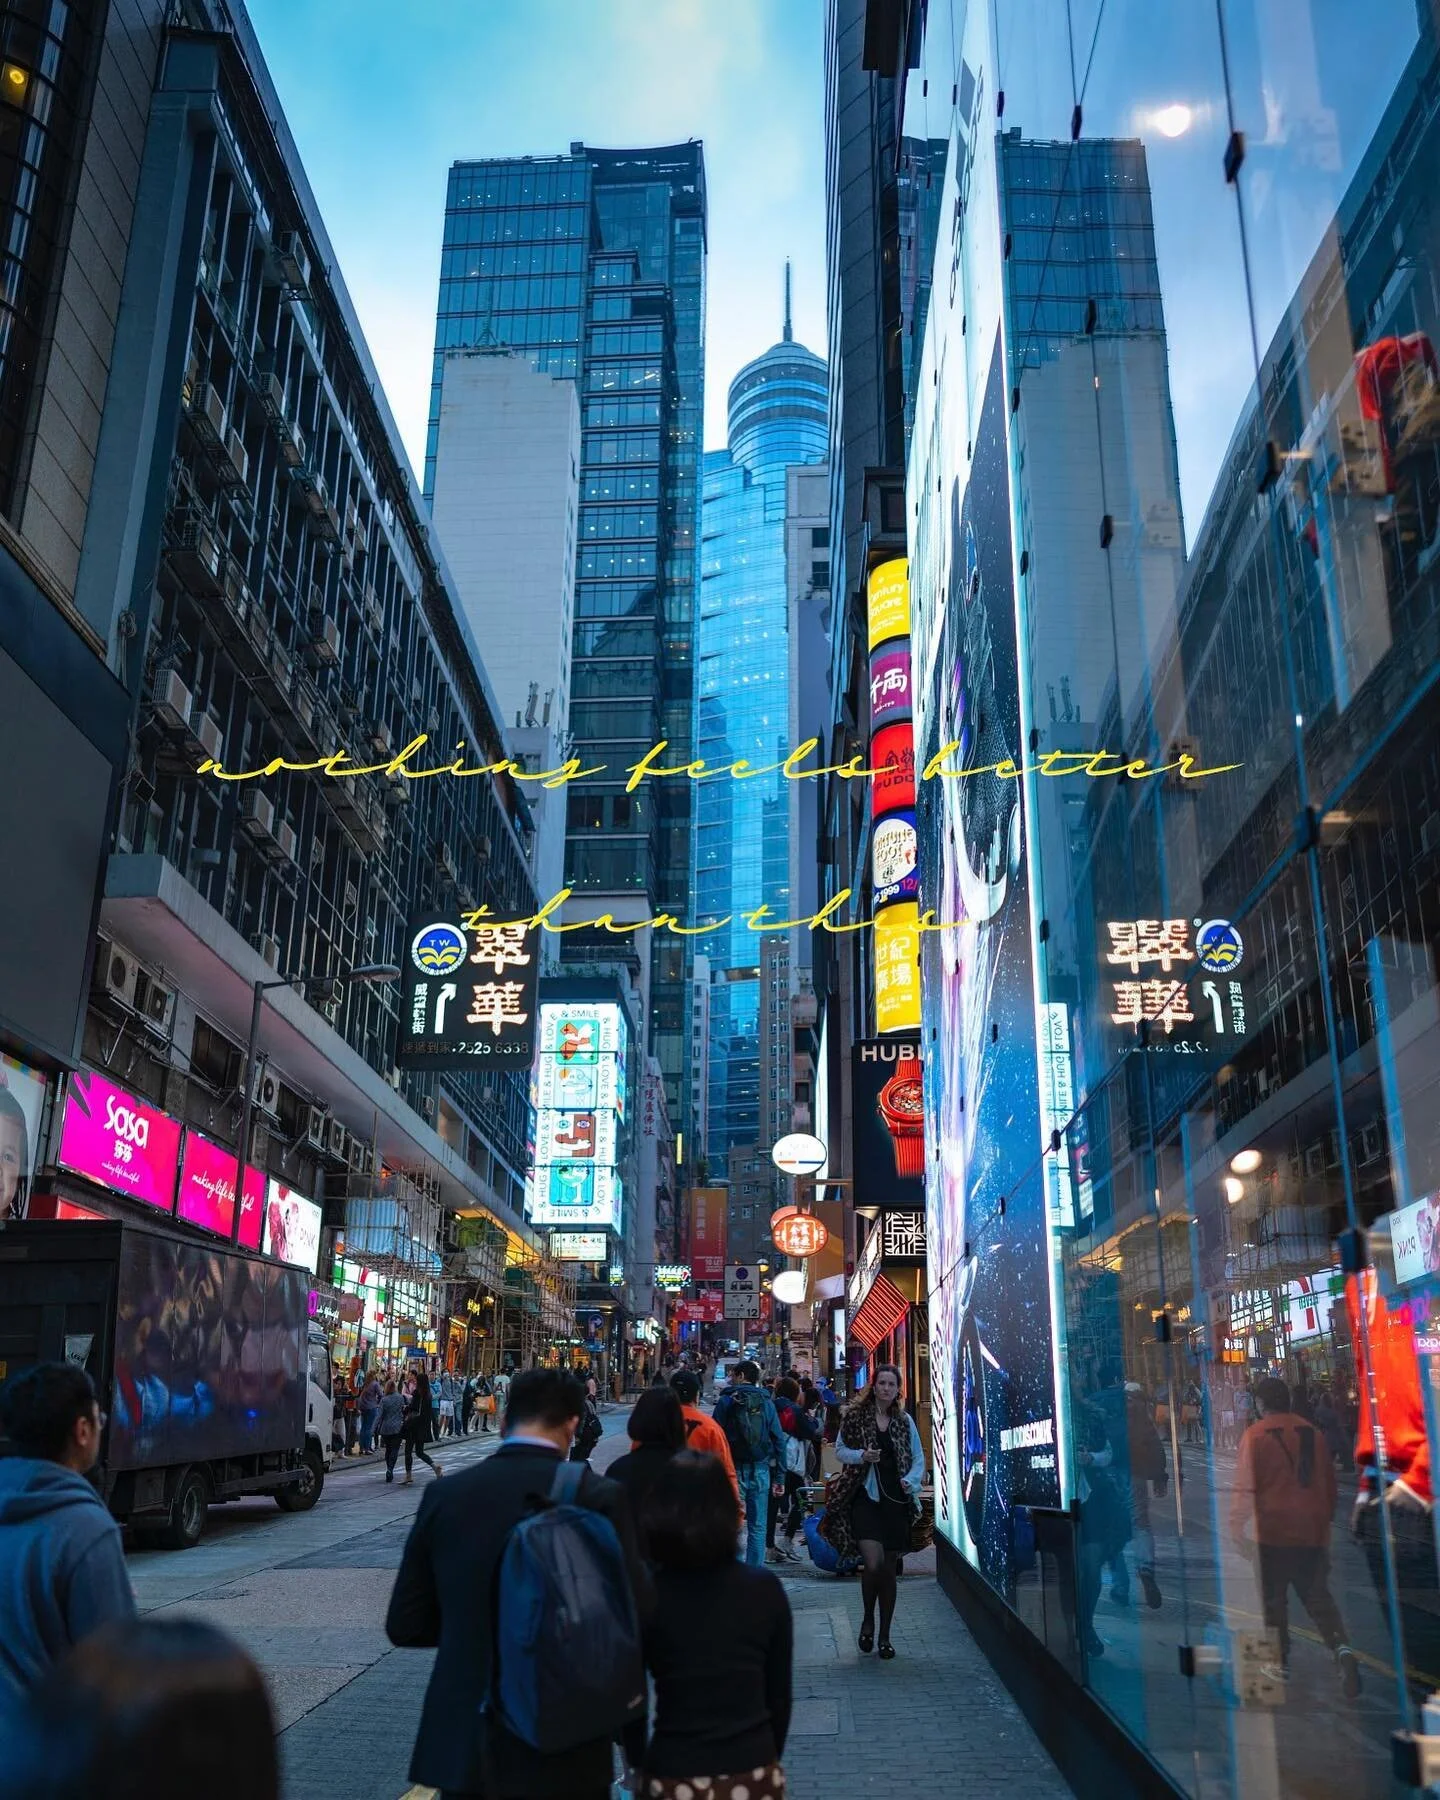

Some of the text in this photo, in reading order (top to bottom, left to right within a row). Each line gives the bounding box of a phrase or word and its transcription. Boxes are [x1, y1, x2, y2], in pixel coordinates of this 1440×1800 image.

[466, 922, 531, 1036] 翠華
[571, 1010, 600, 1018] SMILE
[192, 1170, 215, 1199] making
[215, 1178, 227, 1203] life
[747, 1309, 758, 1317] 12
